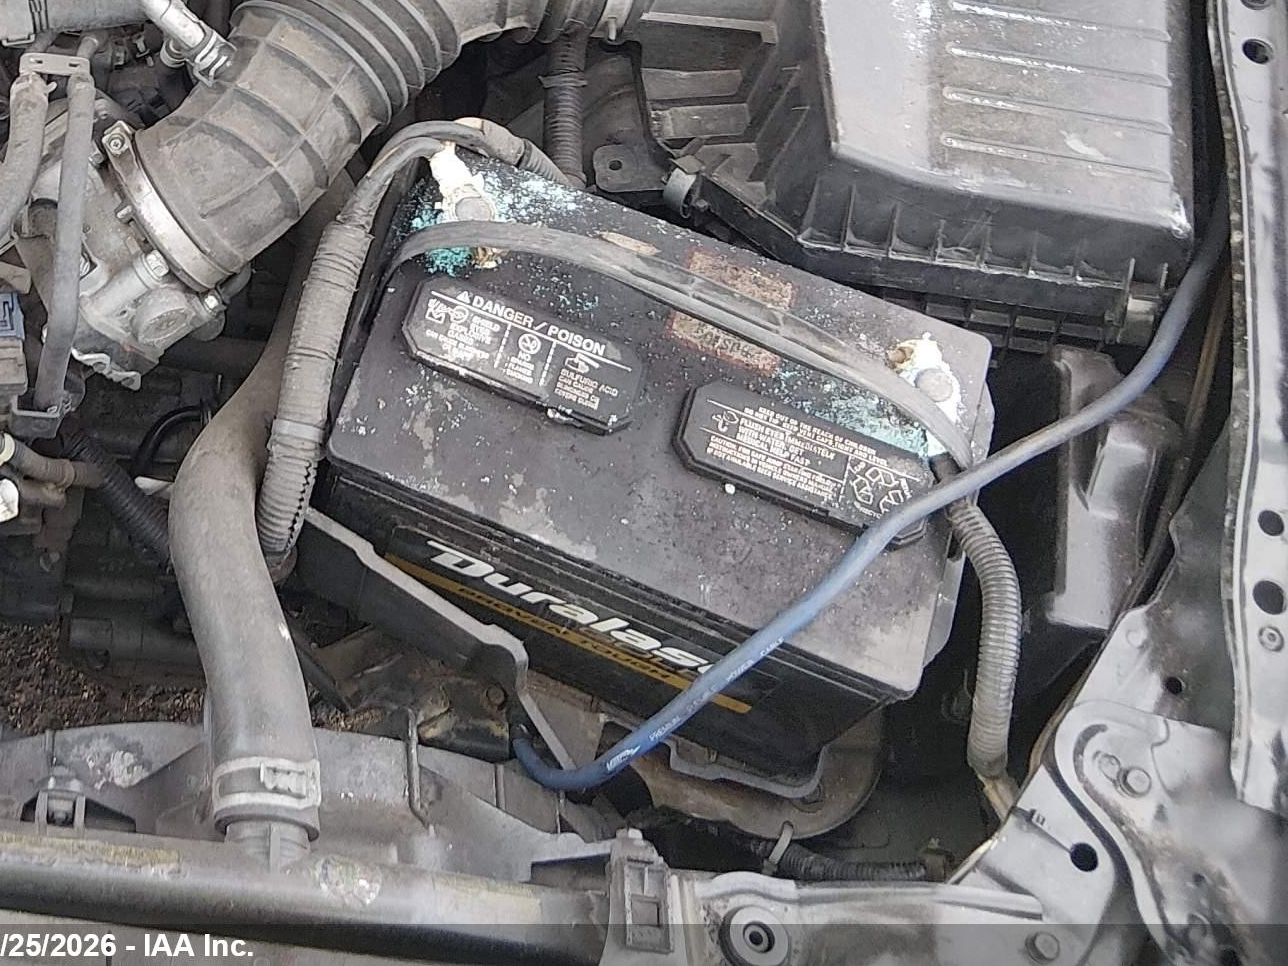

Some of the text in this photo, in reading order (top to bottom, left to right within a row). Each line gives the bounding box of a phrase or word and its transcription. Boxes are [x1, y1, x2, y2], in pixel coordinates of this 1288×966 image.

[471, 294, 534, 328] DANGER
[546, 323, 606, 356] POISON
[516, 349, 532, 362] NO
[592, 381, 619, 398] ACID
[737, 425, 759, 439] WITH
[738, 416, 766, 433] FLUSH
[811, 425, 834, 439] REACH
[735, 432, 770, 451] MEDICAL
